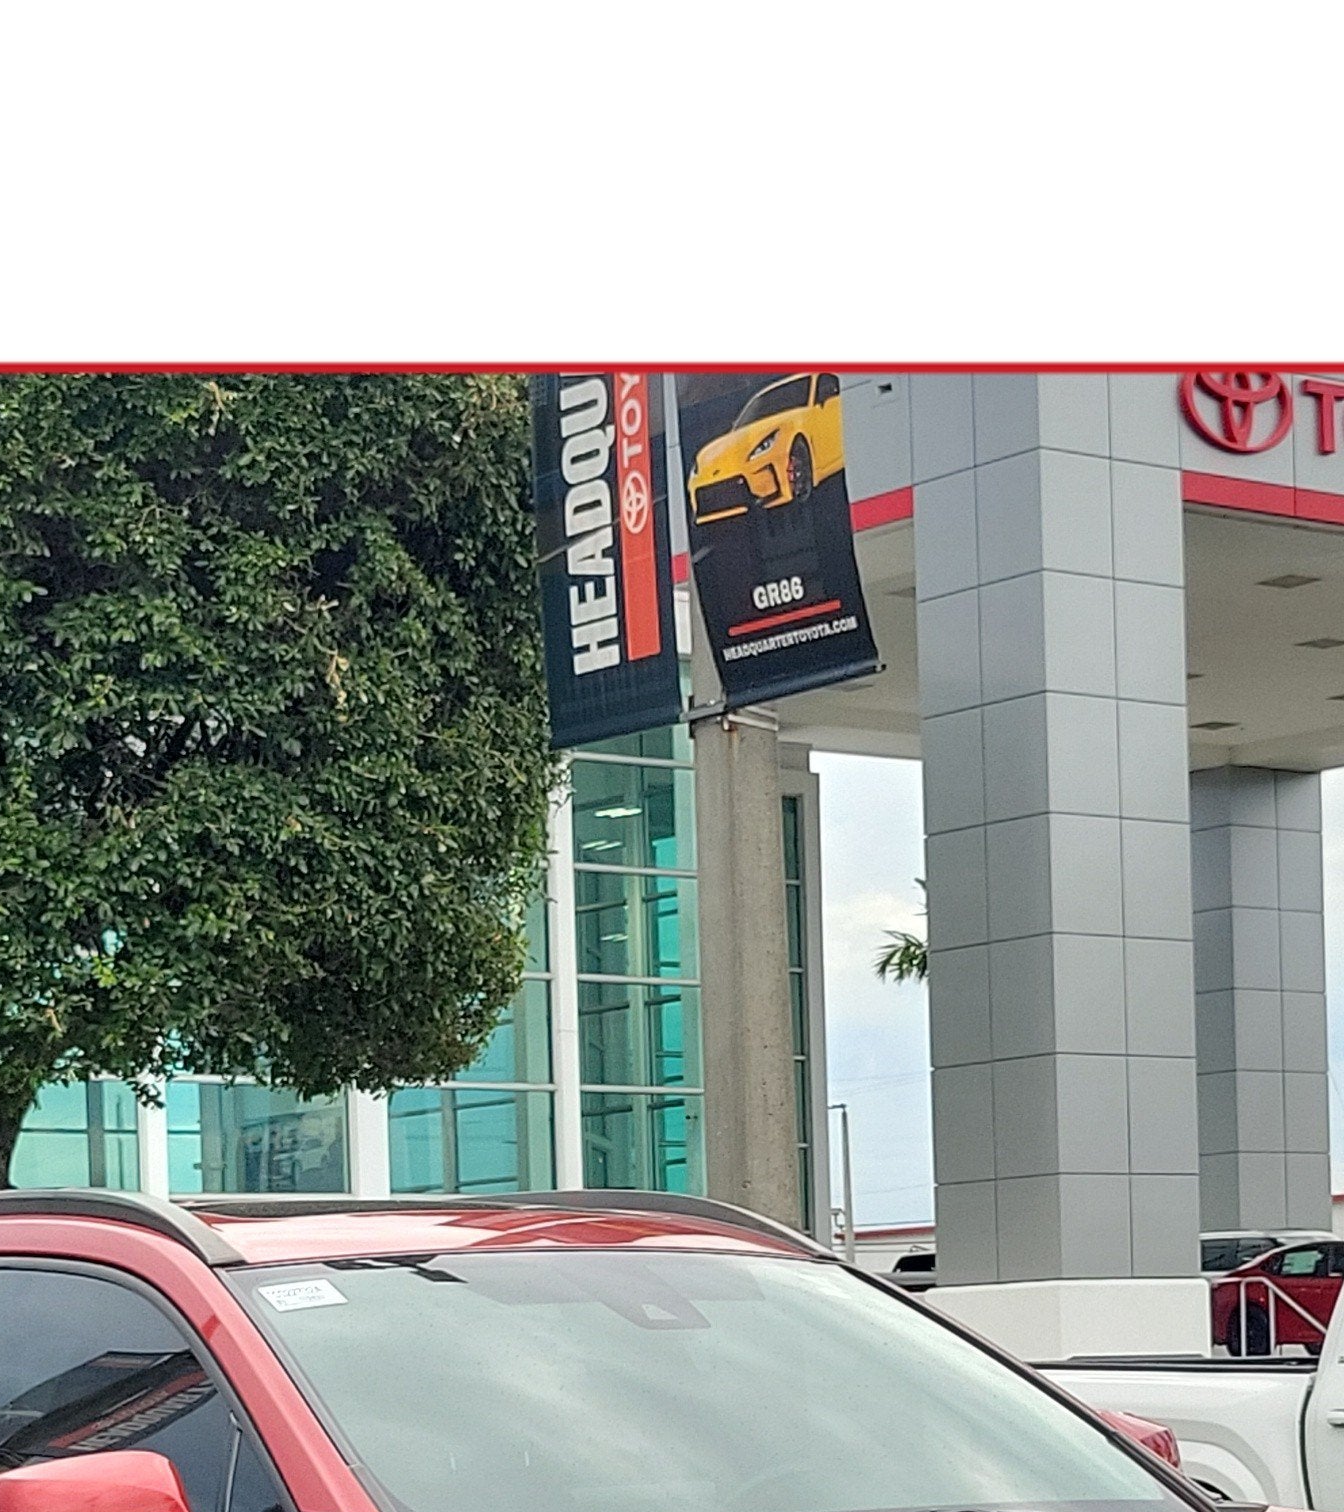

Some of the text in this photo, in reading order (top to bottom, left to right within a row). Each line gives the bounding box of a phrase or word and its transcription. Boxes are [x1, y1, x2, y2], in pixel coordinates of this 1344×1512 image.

[559, 372, 620, 675] HEADQU
[752, 576, 805, 610] GR86
[722, 616, 858, 662] HEADQUARTERTOYOTA.COM
